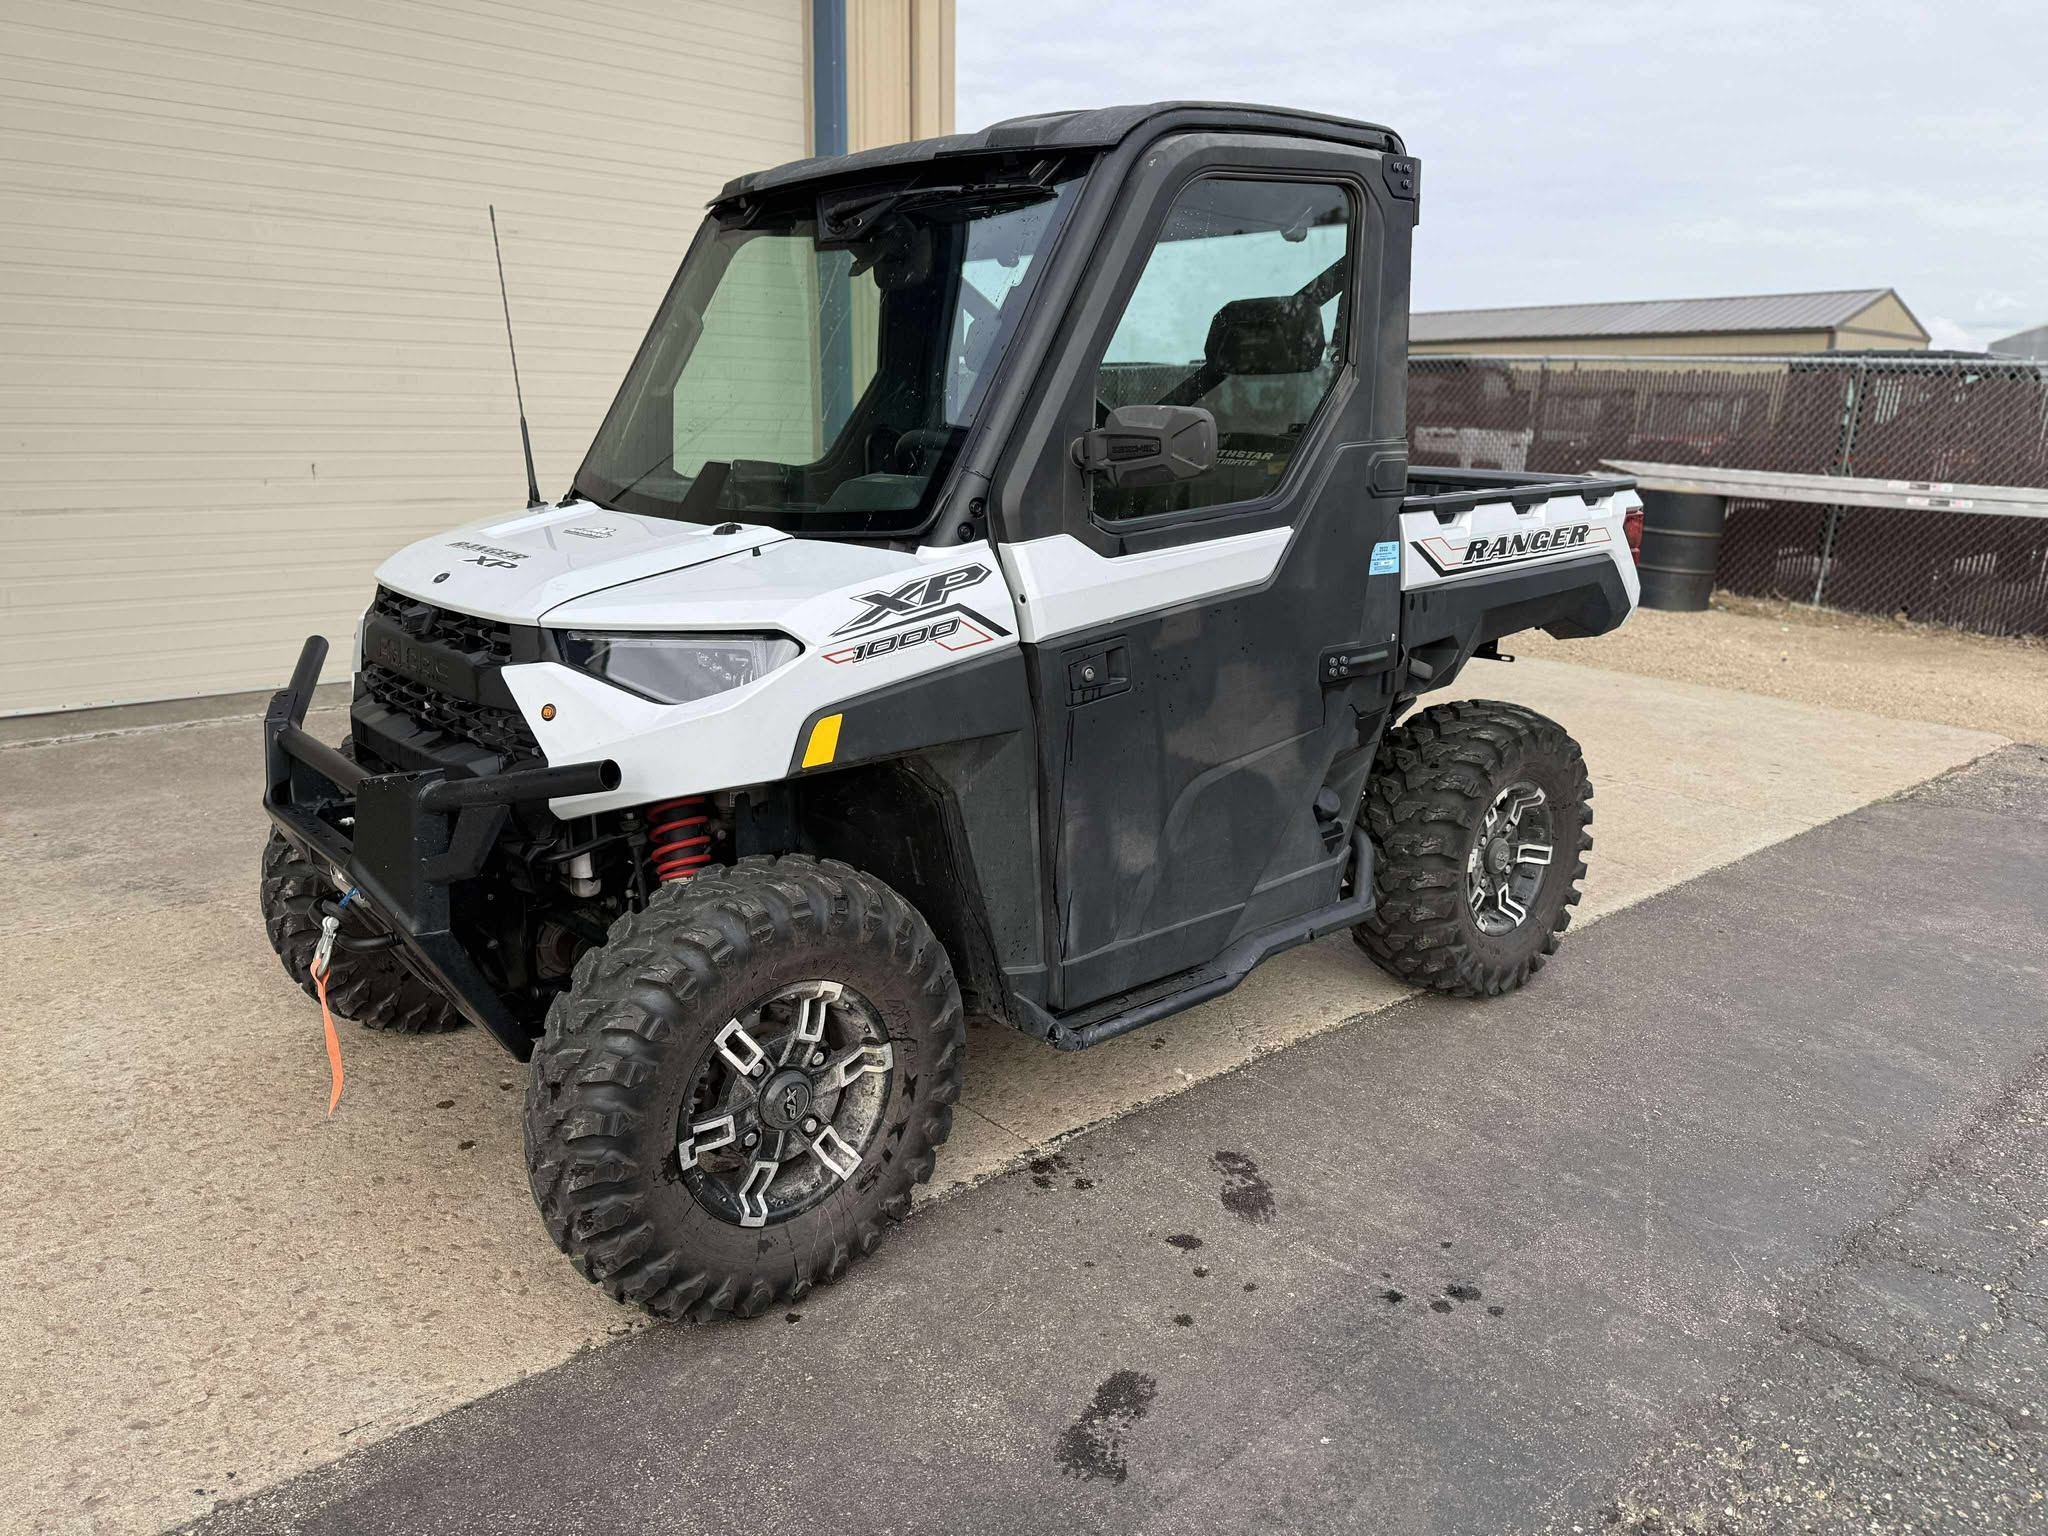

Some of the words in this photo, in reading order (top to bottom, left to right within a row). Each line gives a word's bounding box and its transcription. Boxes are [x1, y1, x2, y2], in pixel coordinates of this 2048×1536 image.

[445, 541, 531, 561] RANGER
[460, 555, 519, 569] XP
[1462, 523, 1591, 564] RANGER
[829, 562, 992, 637] XP
[852, 617, 960, 664] 1000
[785, 1087, 798, 1120] XP
